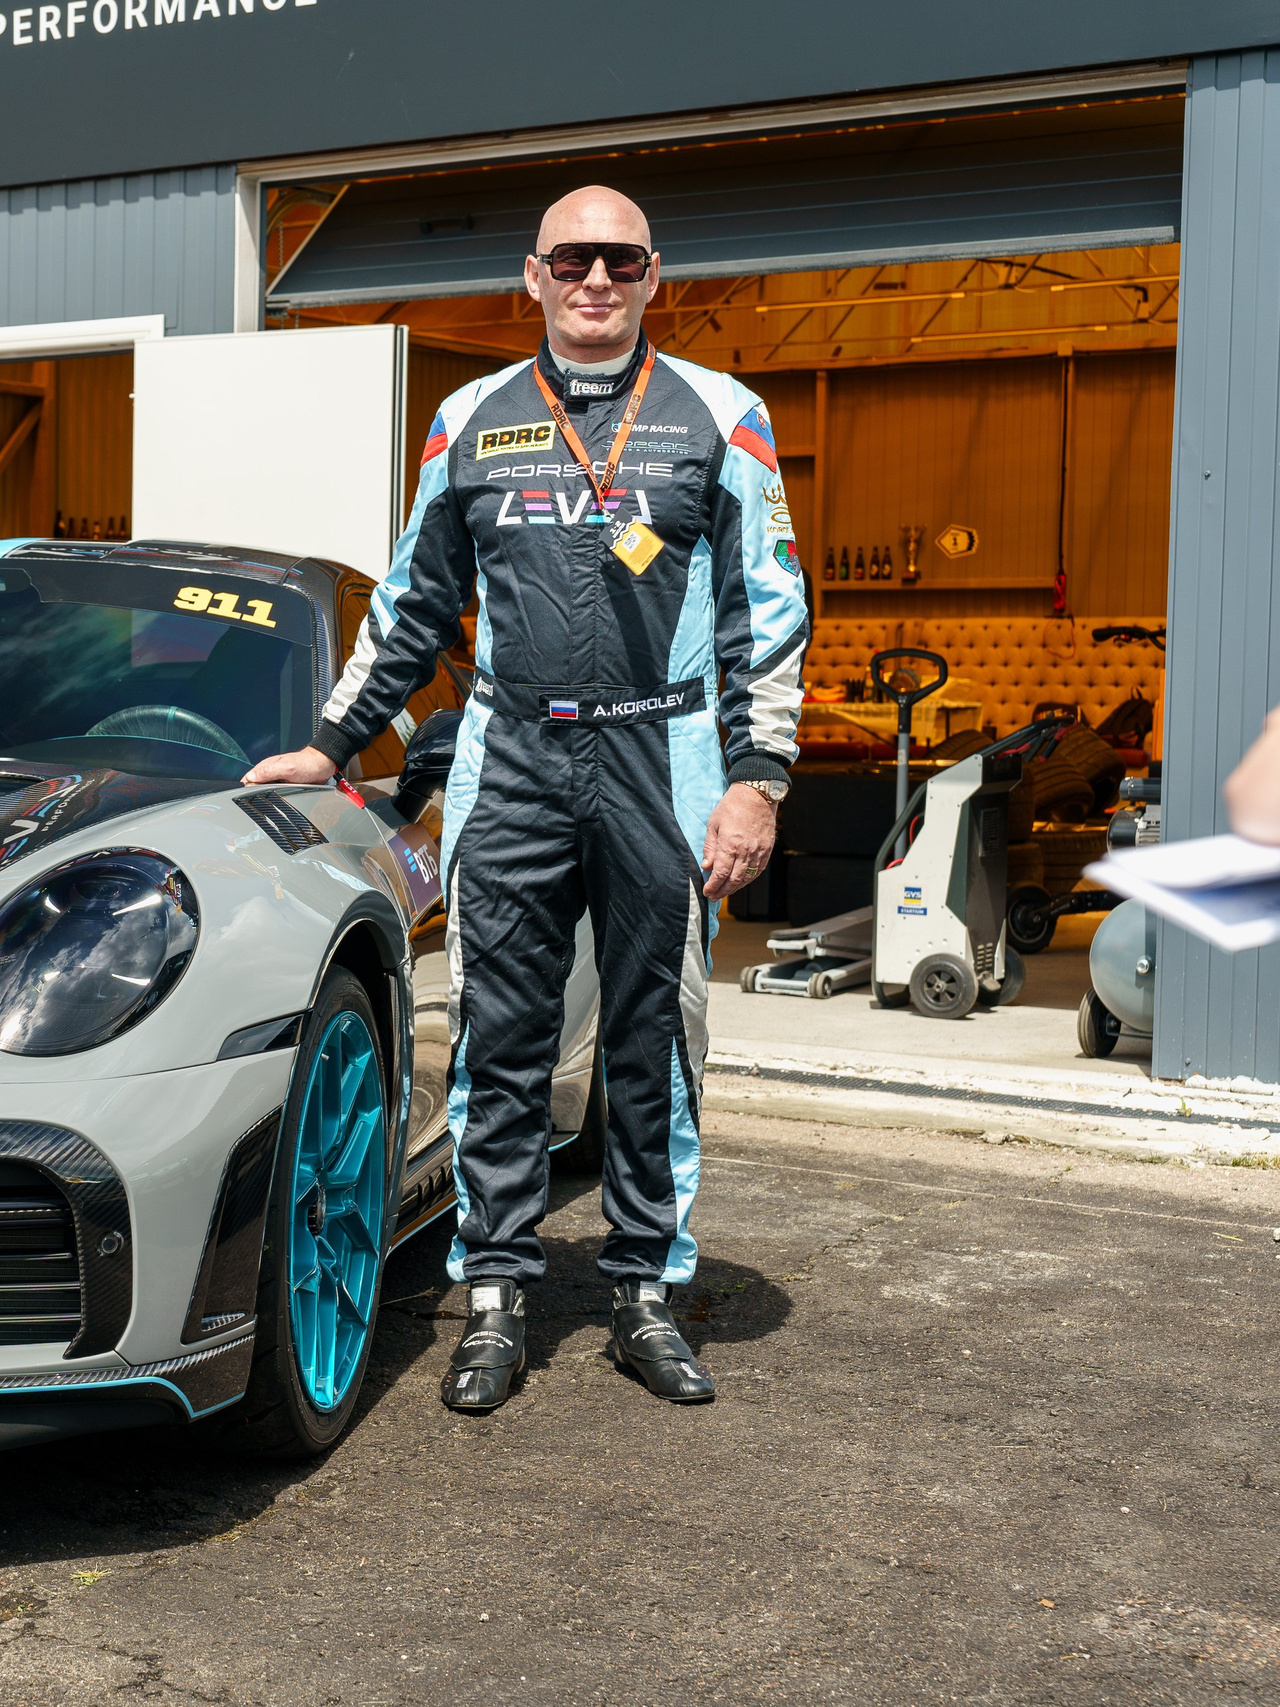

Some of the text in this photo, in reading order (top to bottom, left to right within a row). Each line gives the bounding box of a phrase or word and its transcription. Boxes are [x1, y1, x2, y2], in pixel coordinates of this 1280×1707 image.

[481, 425, 552, 451] RDRC
[629, 424, 689, 434] MP RACING
[486, 461, 674, 481] PORSCHE
[173, 586, 277, 629] 911
[413, 843, 439, 885] ВТБ
